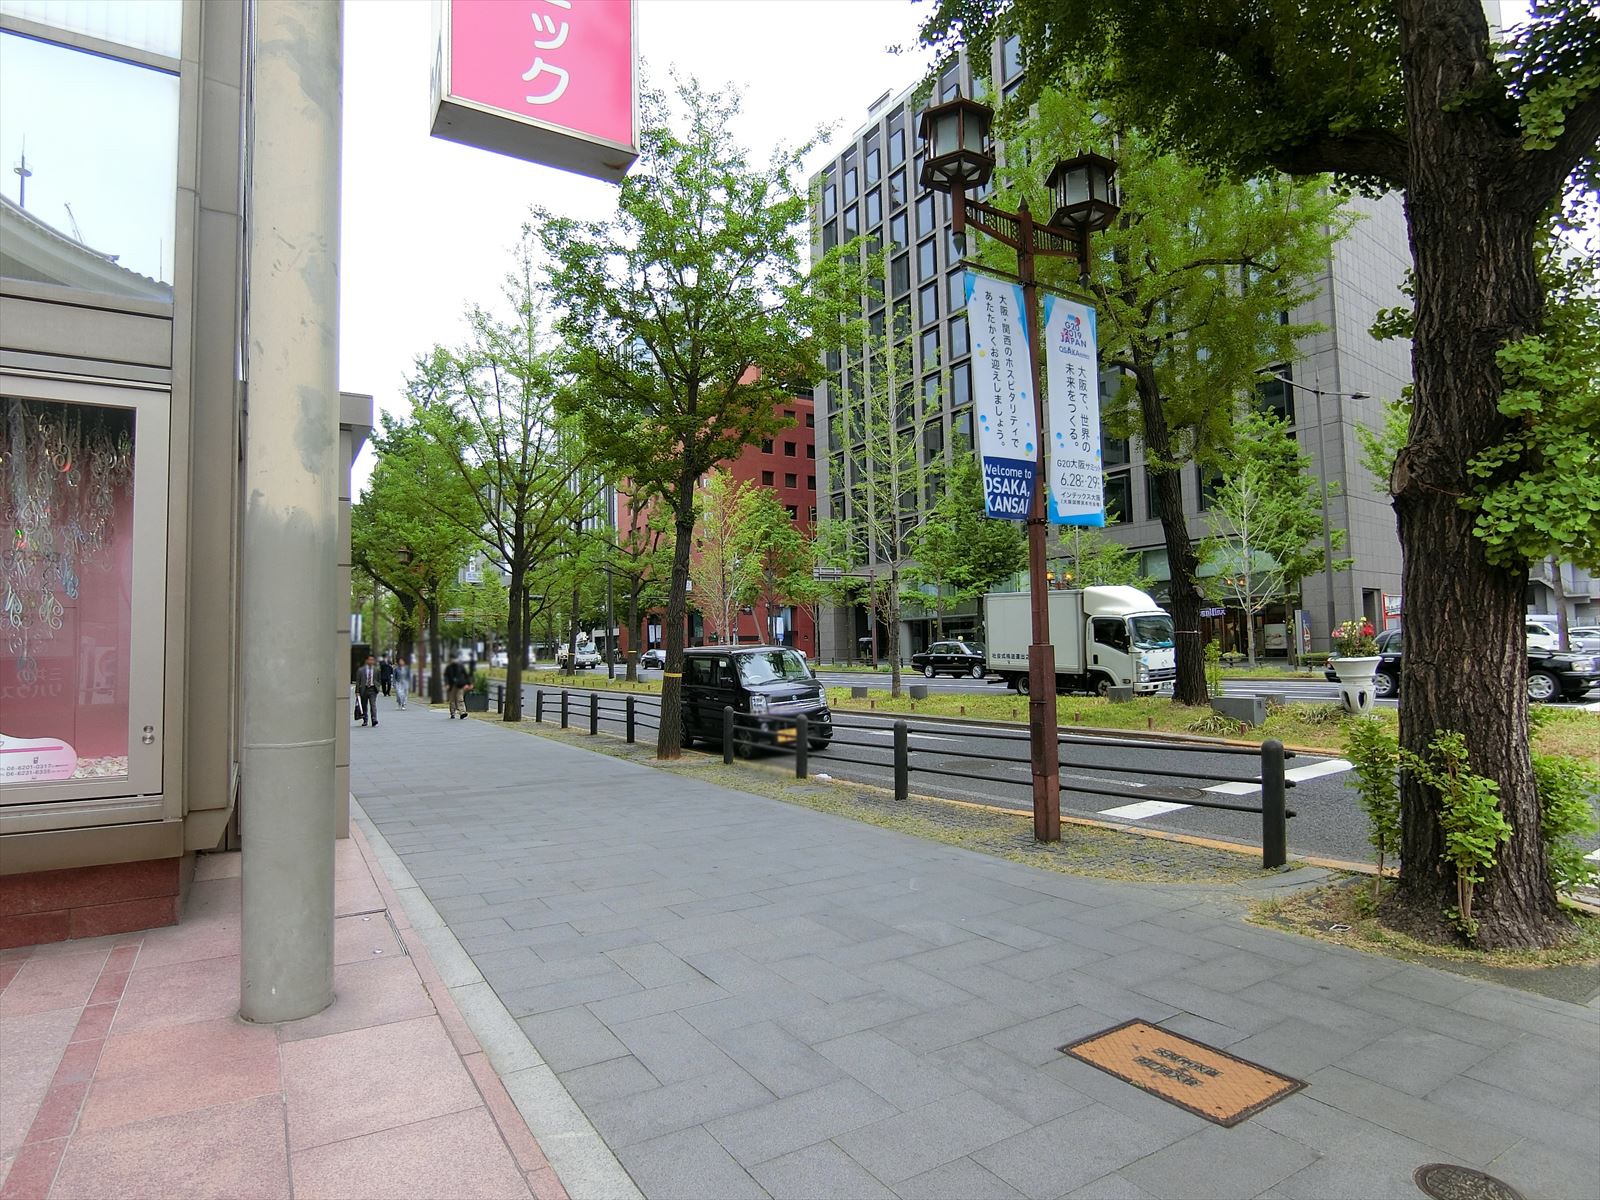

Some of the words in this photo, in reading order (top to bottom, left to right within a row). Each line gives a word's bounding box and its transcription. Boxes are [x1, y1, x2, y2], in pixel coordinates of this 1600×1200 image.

[521, 0, 572, 105] ック
[1063, 328, 1082, 339] 2019
[1064, 321, 1080, 332] G20
[1060, 335, 1087, 348] JAPAN
[984, 291, 1006, 447] あたたかくお迎えしましょう。
[998, 294, 1020, 449] 大阪・関西のホスピタリティで
[1065, 362, 1079, 447] 未来をつくる。
[1077, 365, 1091, 453] 大阪で、世界の
[985, 463, 1023, 479] Welcome
[1024, 468, 1032, 479] to
[985, 476, 1031, 498] OSAKA,
[986, 495, 1029, 515] KANSAI
